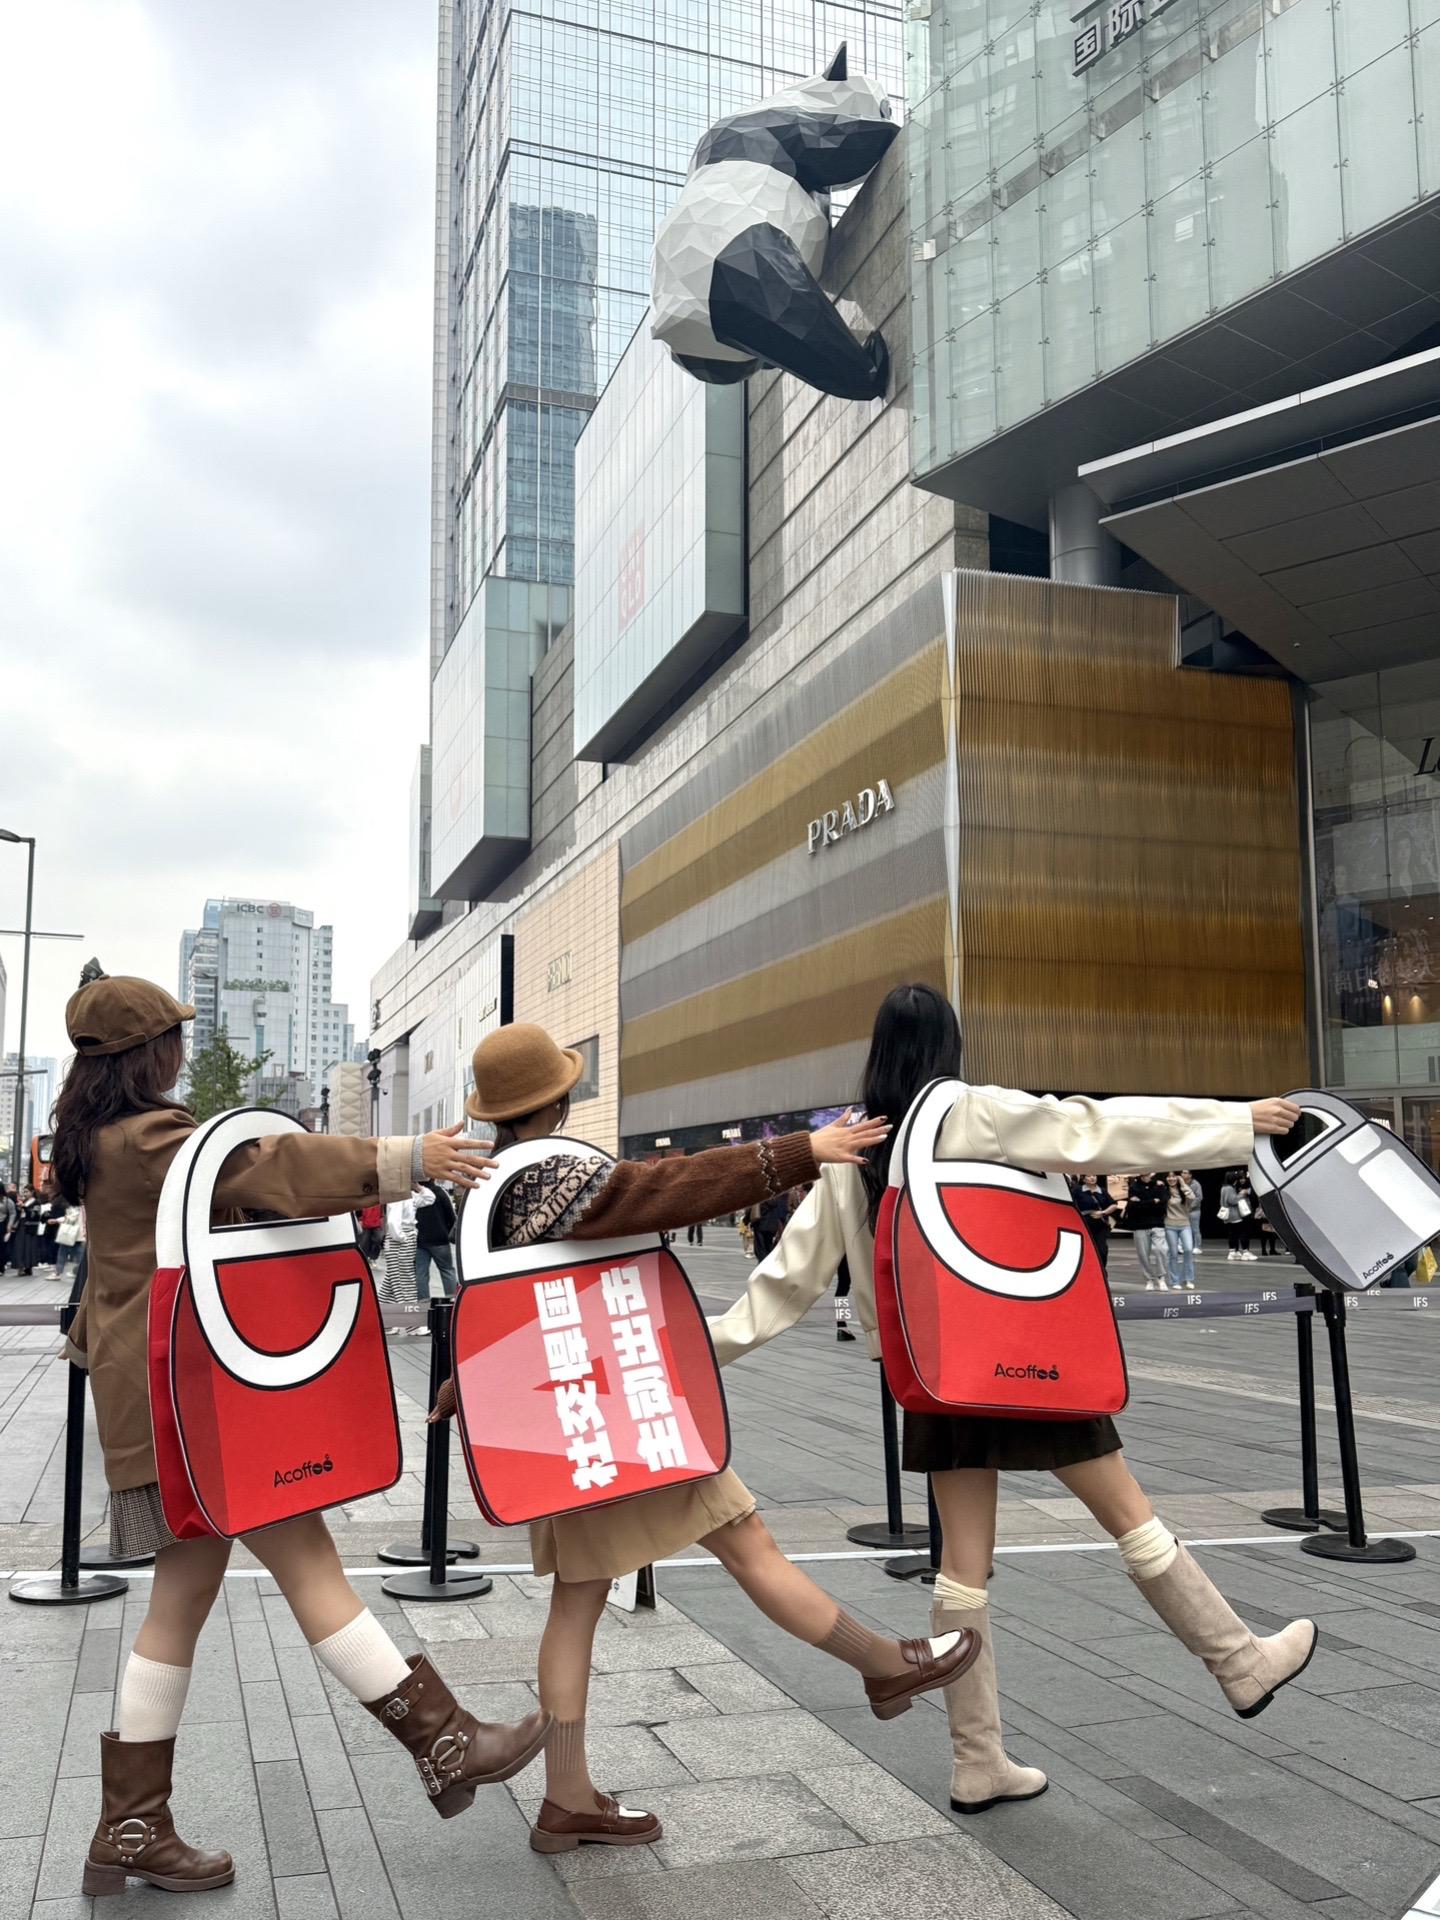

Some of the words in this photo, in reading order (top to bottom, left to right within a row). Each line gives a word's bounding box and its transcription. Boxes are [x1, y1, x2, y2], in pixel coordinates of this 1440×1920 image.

[1413, 737, 1440, 776] L
[807, 779, 895, 855] PRADA
[236, 903, 264, 914] ICBC
[1187, 1294, 1202, 1304] IFS
[1263, 1291, 1277, 1301] IFS
[1413, 1296, 1428, 1307] IFS
[835, 1298, 849, 1307] IFS
[1112, 1297, 1125, 1307] FS
[1163, 1307, 1179, 1317] IFS
[1245, 1303, 1260, 1313] IFS
[836, 1308, 852, 1320] IFS
[600, 1265, 688, 1472] 主动出击
[994, 1363, 1059, 1380] Acoffee
[533, 1276, 618, 1490] 社交悍匪
[273, 1454, 333, 1488] Acoffee
